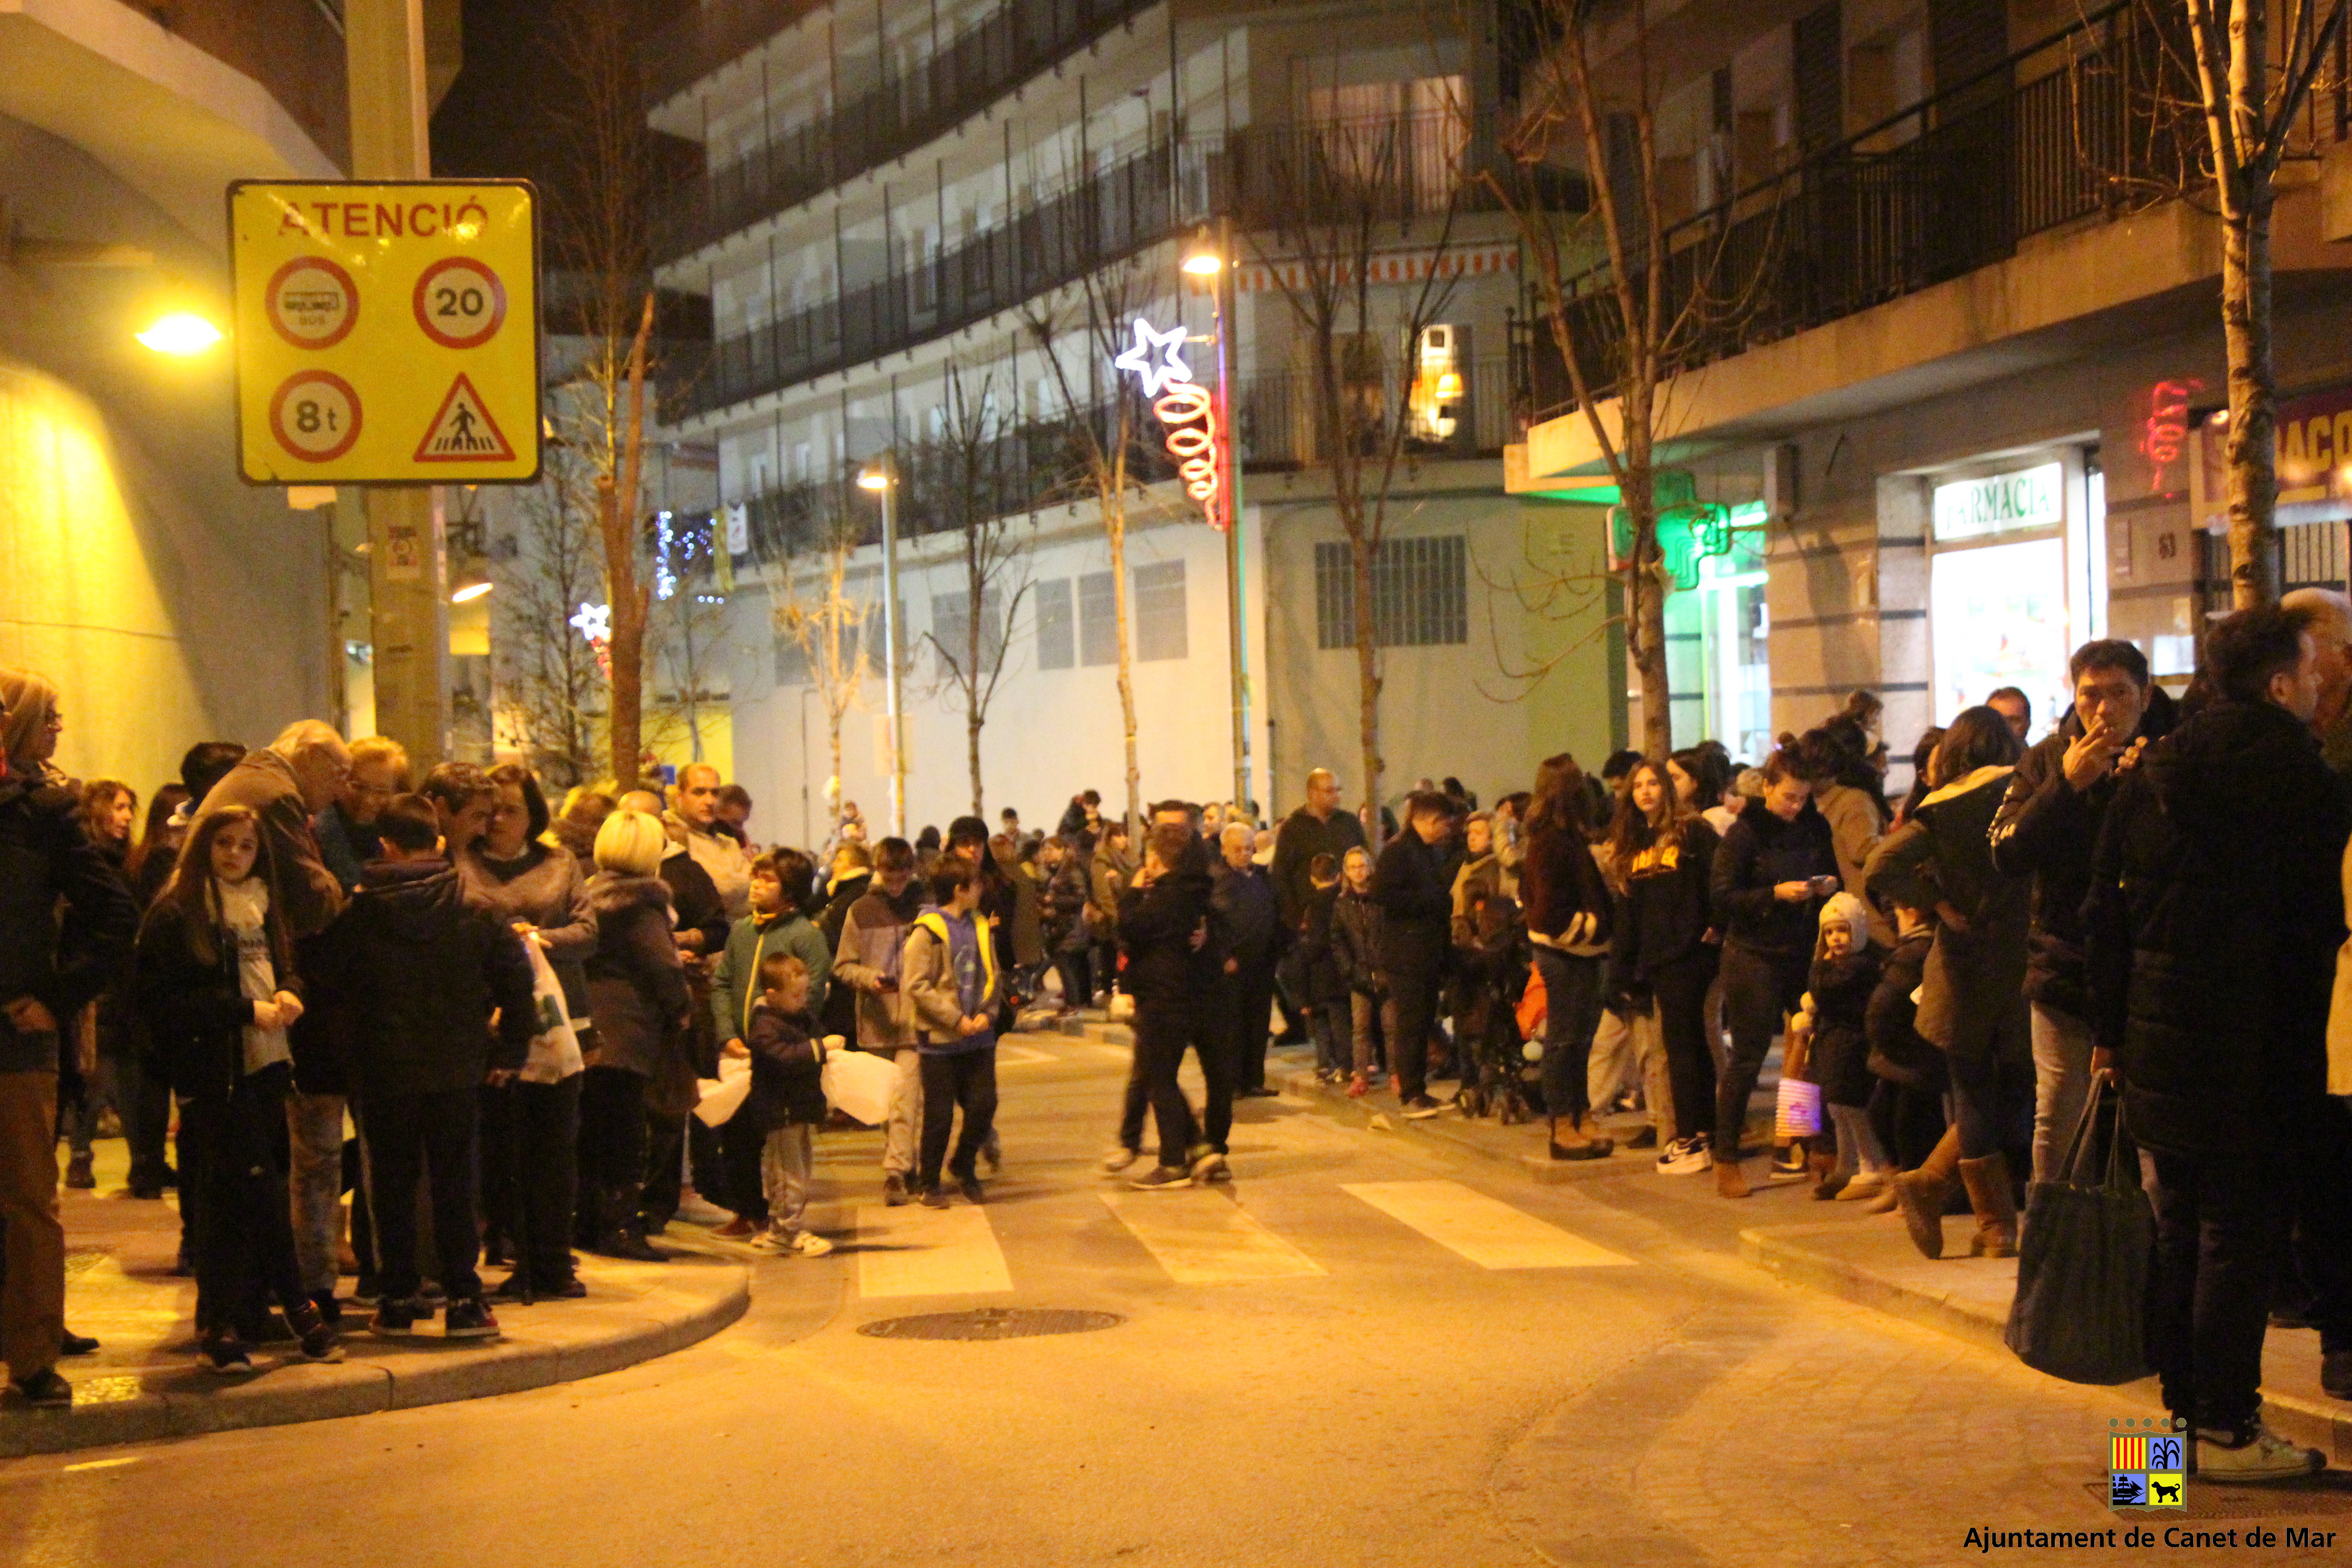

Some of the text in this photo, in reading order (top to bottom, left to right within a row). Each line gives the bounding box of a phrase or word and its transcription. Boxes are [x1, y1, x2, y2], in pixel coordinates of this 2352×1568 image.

[277, 194, 489, 237] ATENCIÓ
[435, 287, 484, 317] 20
[1946, 478, 2050, 532] FARMACIA
